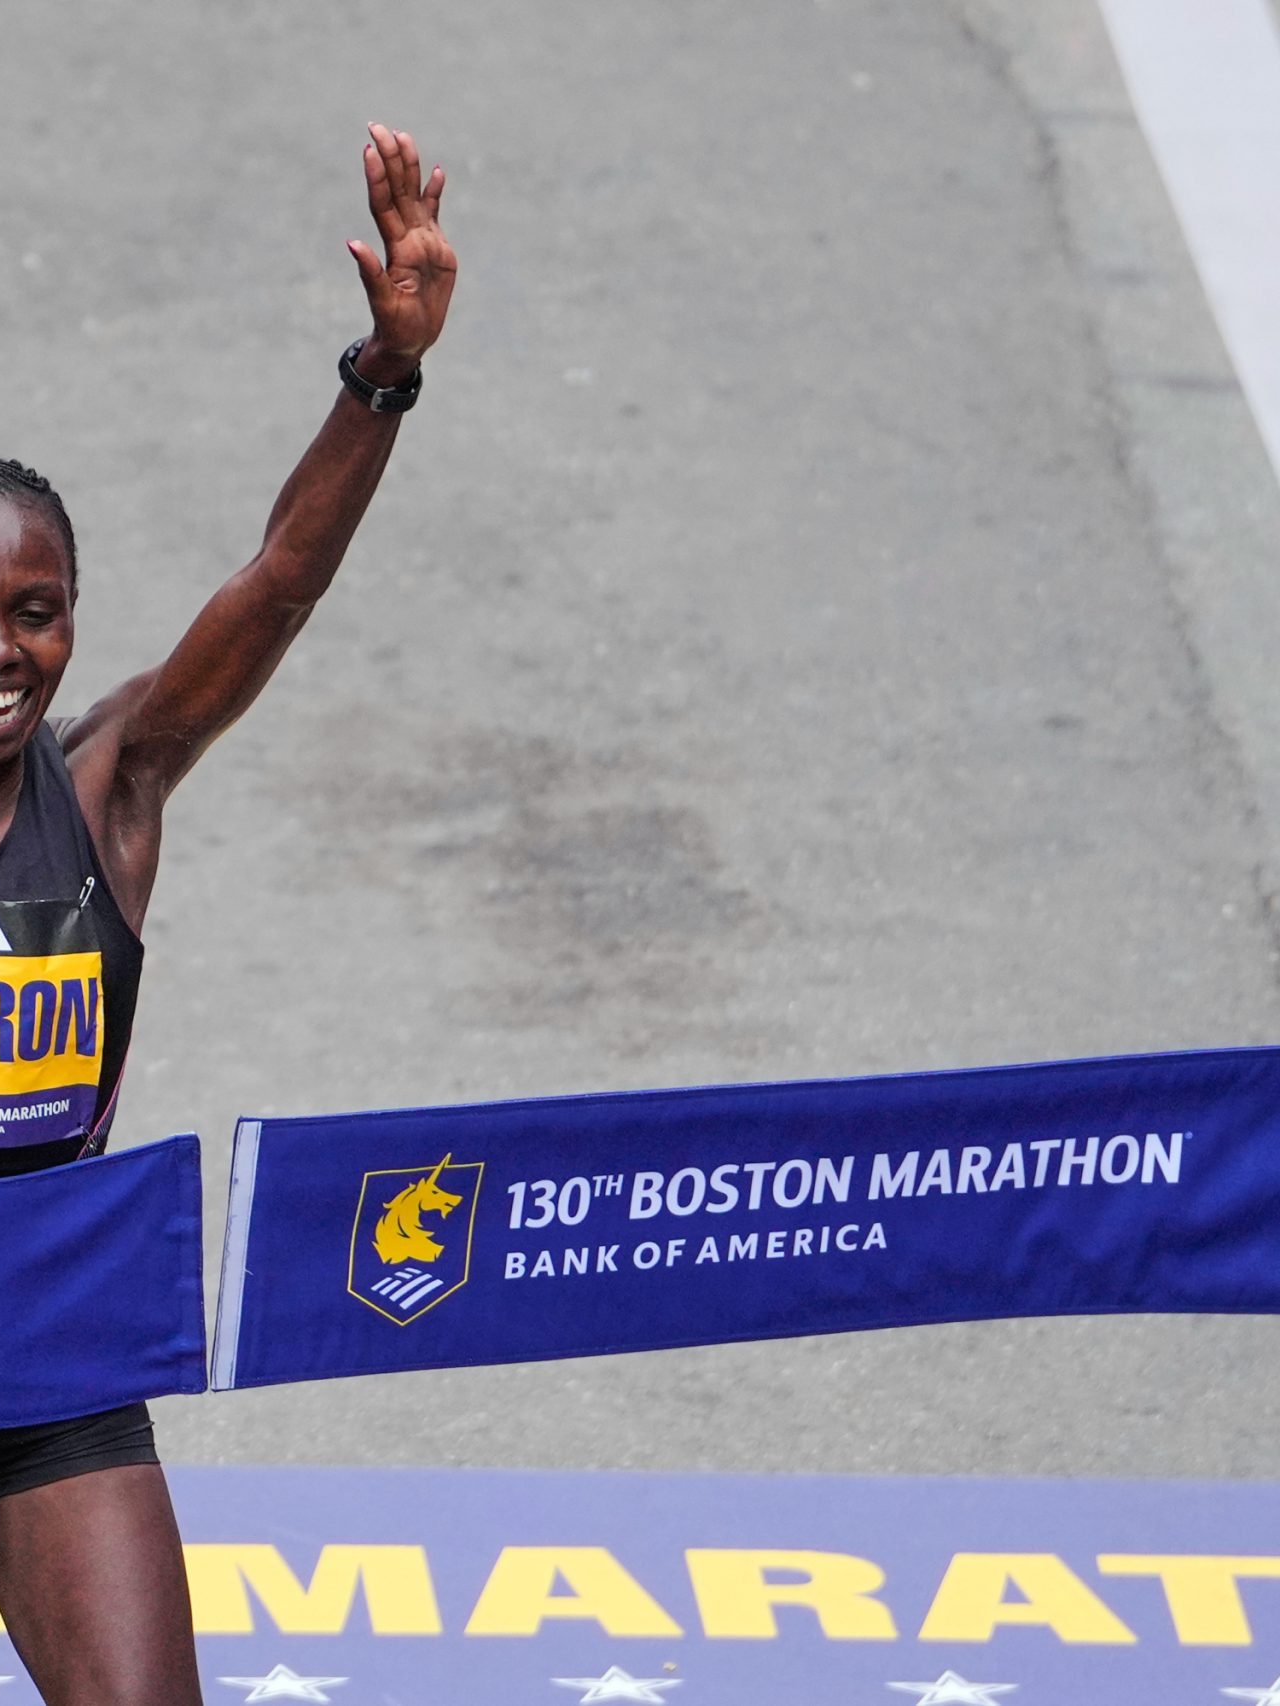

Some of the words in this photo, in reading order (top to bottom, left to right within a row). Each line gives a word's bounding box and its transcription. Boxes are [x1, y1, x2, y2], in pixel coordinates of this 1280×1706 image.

[507, 1174, 624, 1229] 130TH
[629, 1156, 855, 1220] BOSTON
[867, 1132, 1184, 1200] MARATHON
[504, 1241, 620, 1280] BANK
[632, 1238, 687, 1270] OF
[695, 1222, 888, 1265] AMERICA
